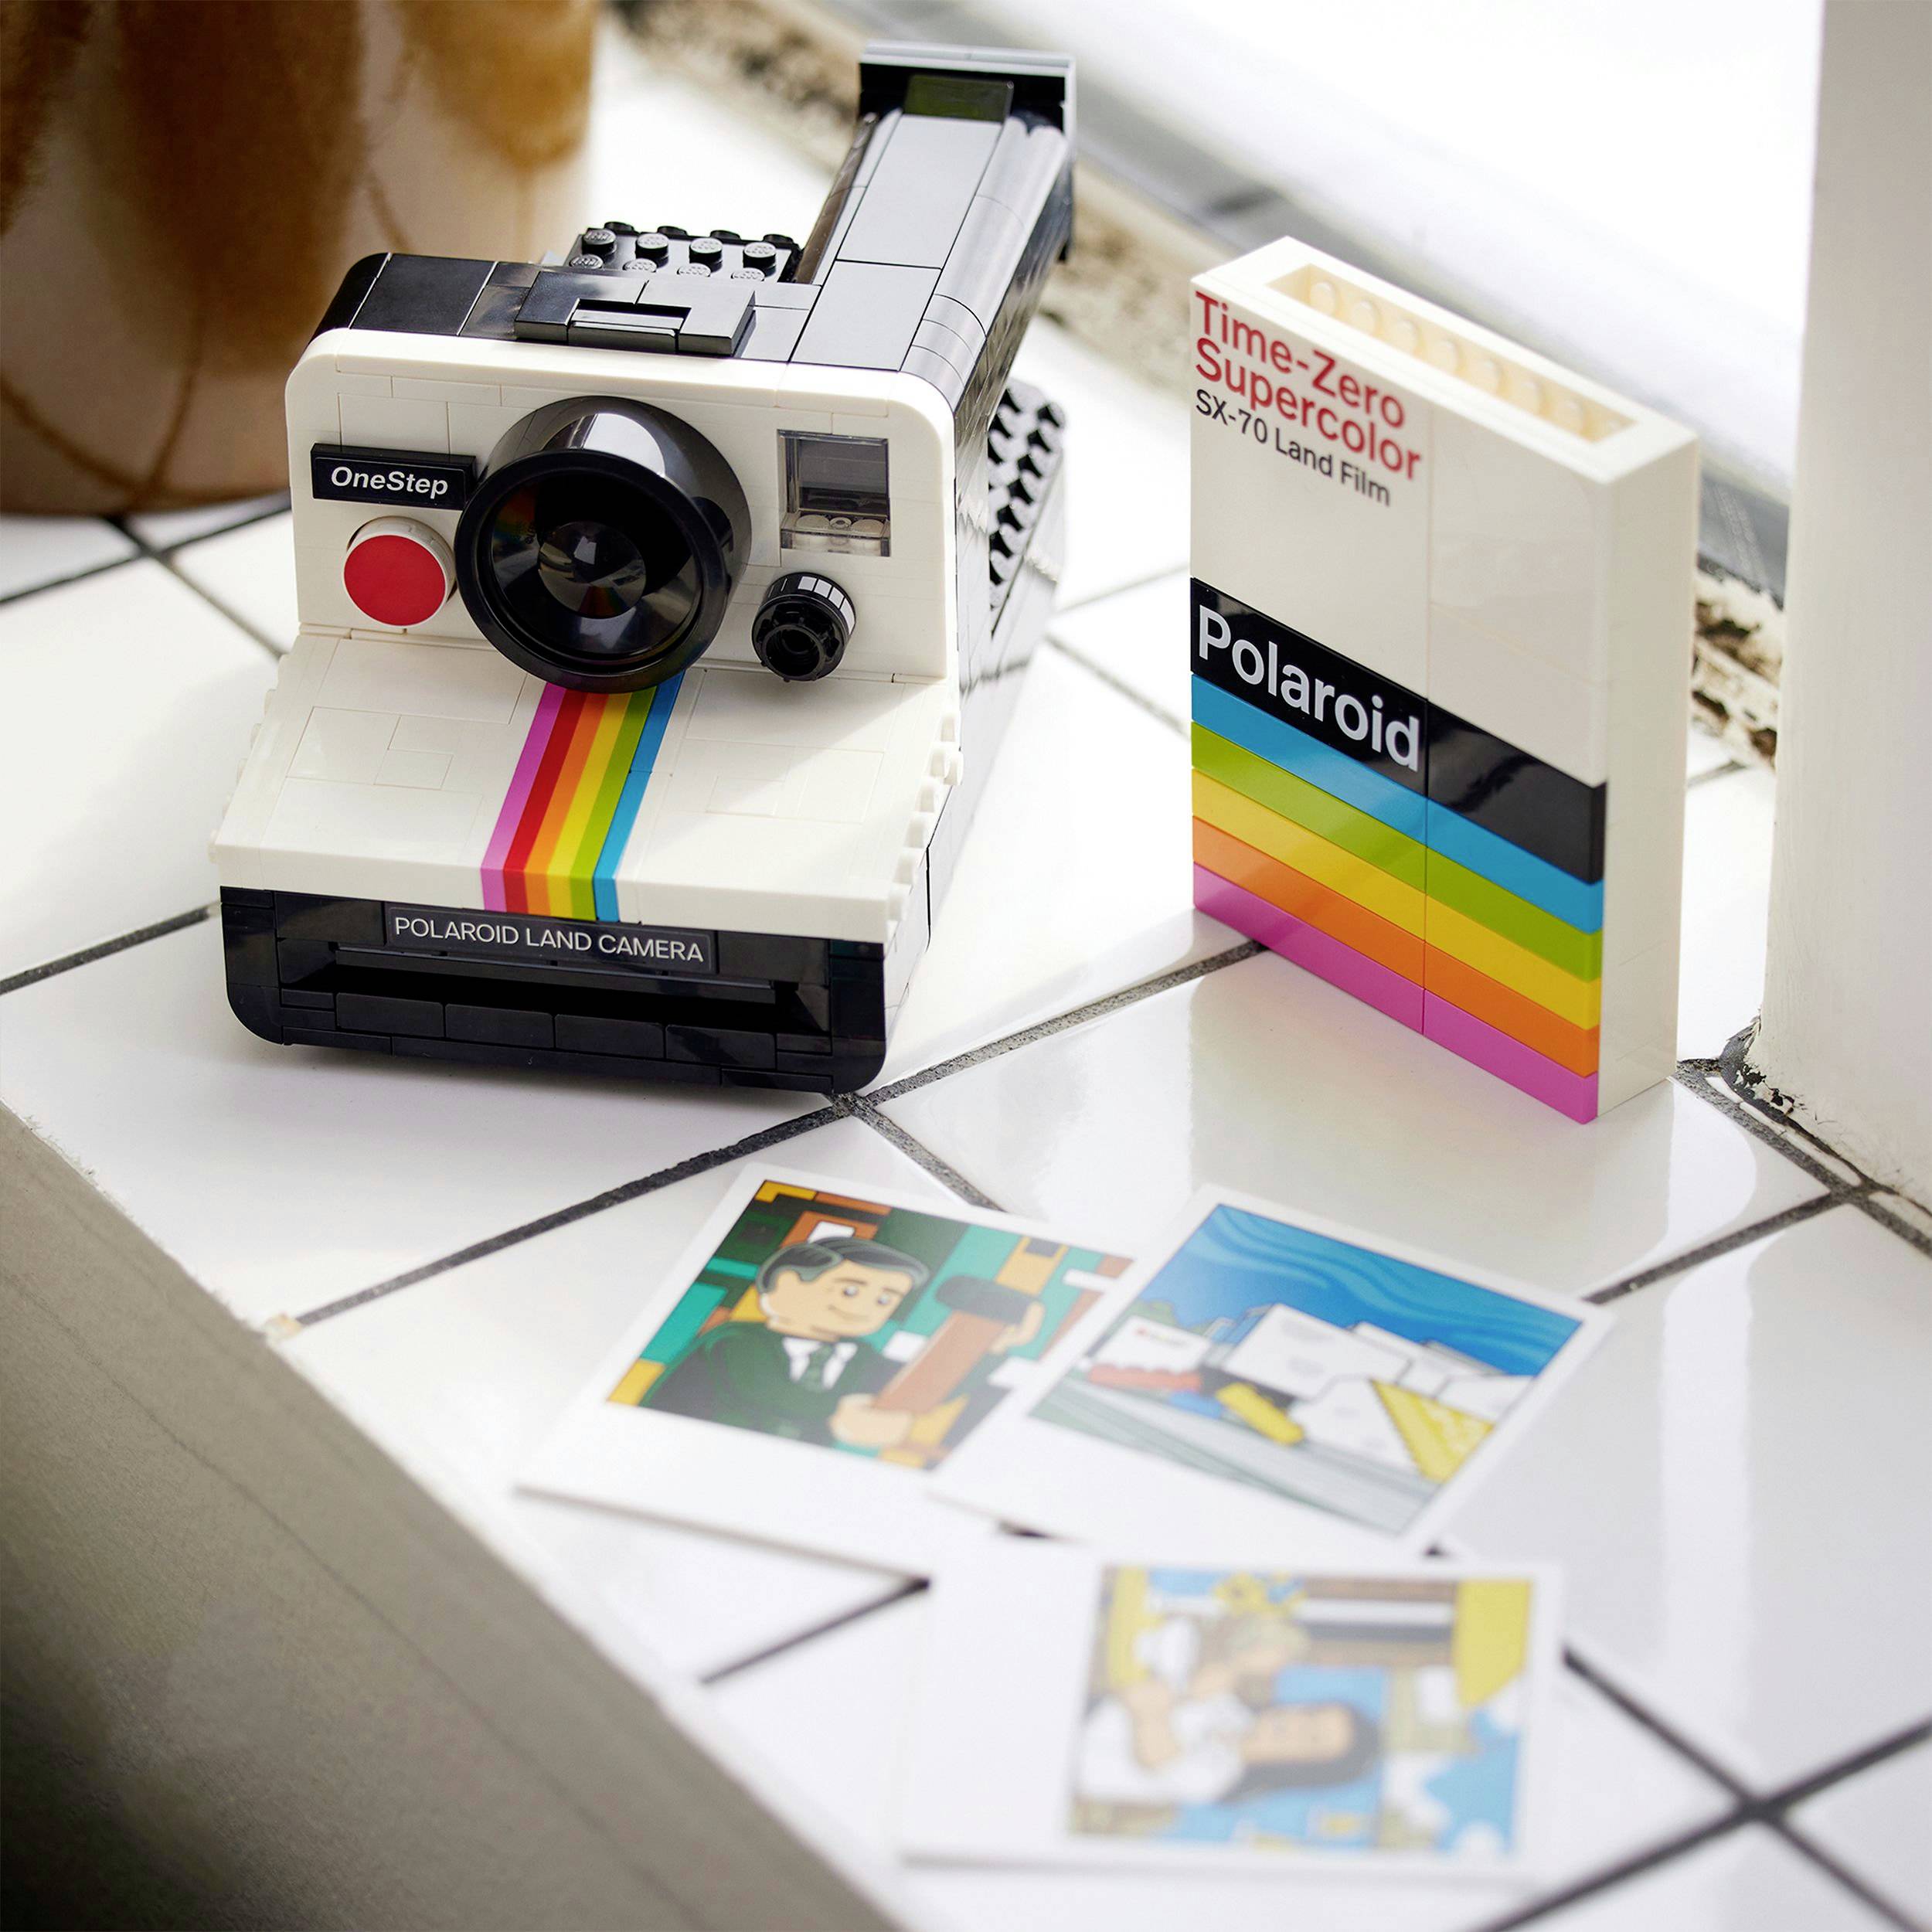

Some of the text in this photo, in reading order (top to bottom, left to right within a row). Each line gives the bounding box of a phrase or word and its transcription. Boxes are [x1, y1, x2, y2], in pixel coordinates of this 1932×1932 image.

[1196, 291, 1405, 429] Time-Zero
[1196, 337, 1421, 480] Supercolor
[331, 466, 449, 499] OneStep
[1196, 389, 1390, 506] SX-70 Land Film
[1199, 604, 1420, 772] Polaroid
[395, 917, 704, 962] POLAROID LAND CAMERA
